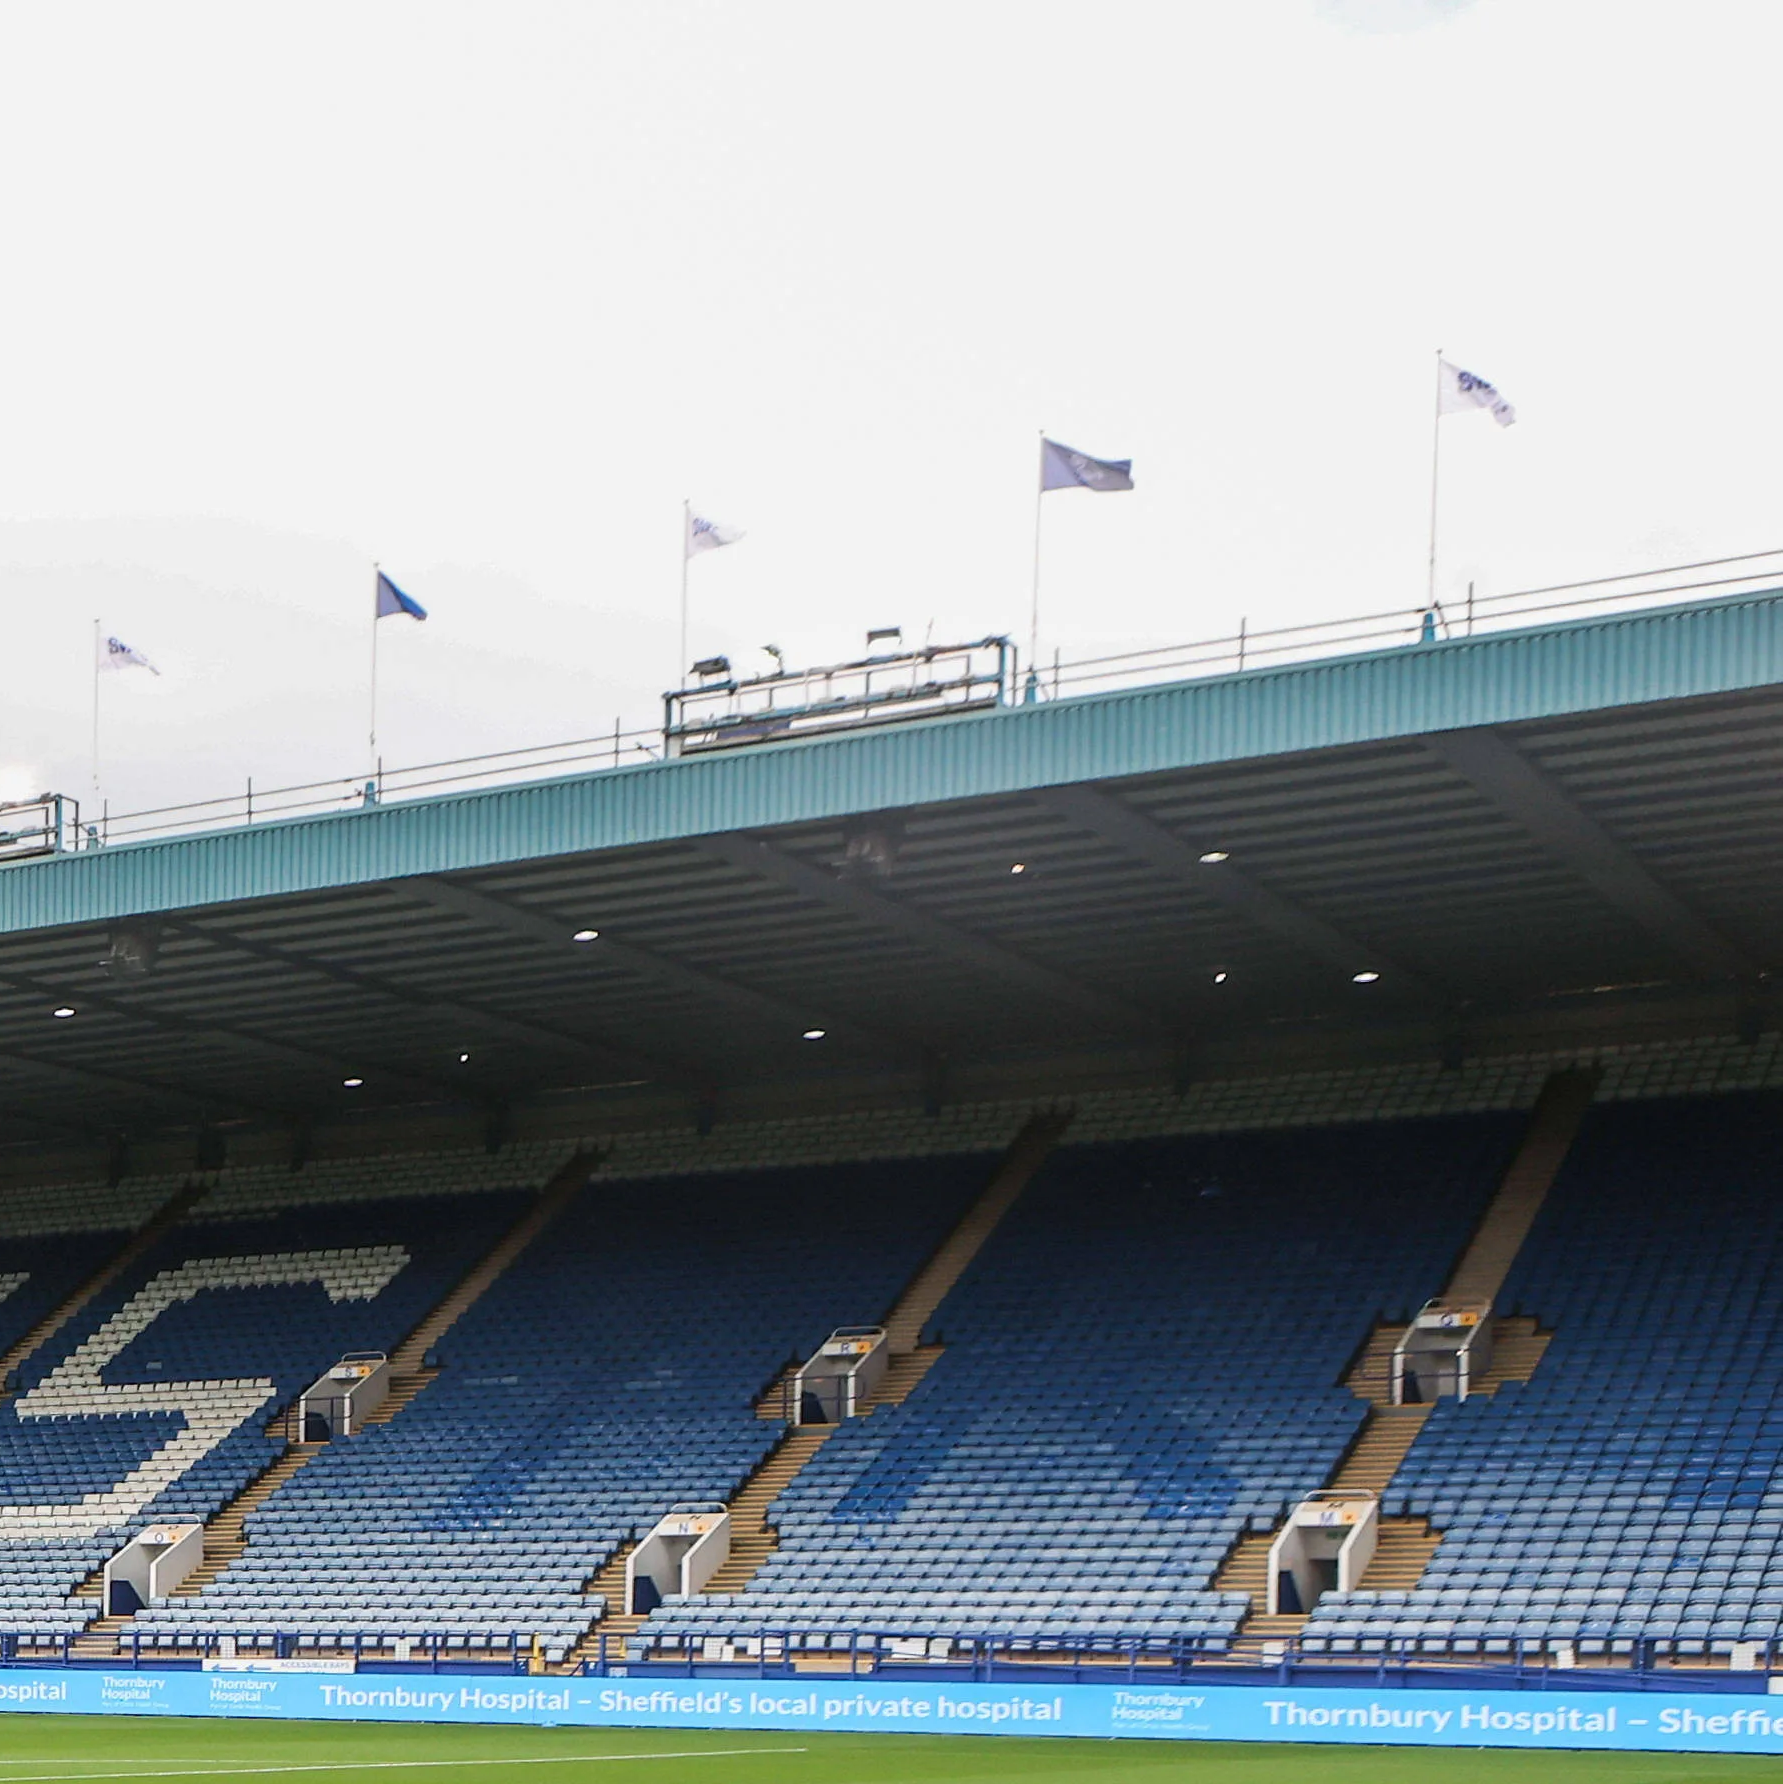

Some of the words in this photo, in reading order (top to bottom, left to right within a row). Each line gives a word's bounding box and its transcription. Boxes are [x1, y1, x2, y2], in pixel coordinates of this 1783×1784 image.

[102, 1676, 166, 1689] Thornbury
[211, 1677, 278, 1692] Thornbury
[102, 1688, 150, 1701] Hospital
[210, 1690, 261, 1703] Hospital
[1114, 1692, 1206, 1709] Thornbury
[320, 1685, 453, 1711] Thornbury
[459, 1687, 570, 1713] Hospital
[599, 1690, 742, 1714] Sheffield's
[749, 1692, 814, 1716] local
[824, 1694, 930, 1720] private
[937, 1696, 1062, 1724] hospital
[1112, 1706, 1184, 1722] Hospital
[1263, 1701, 1451, 1735] Thornbury
[1460, 1705, 1617, 1738] Hospital
